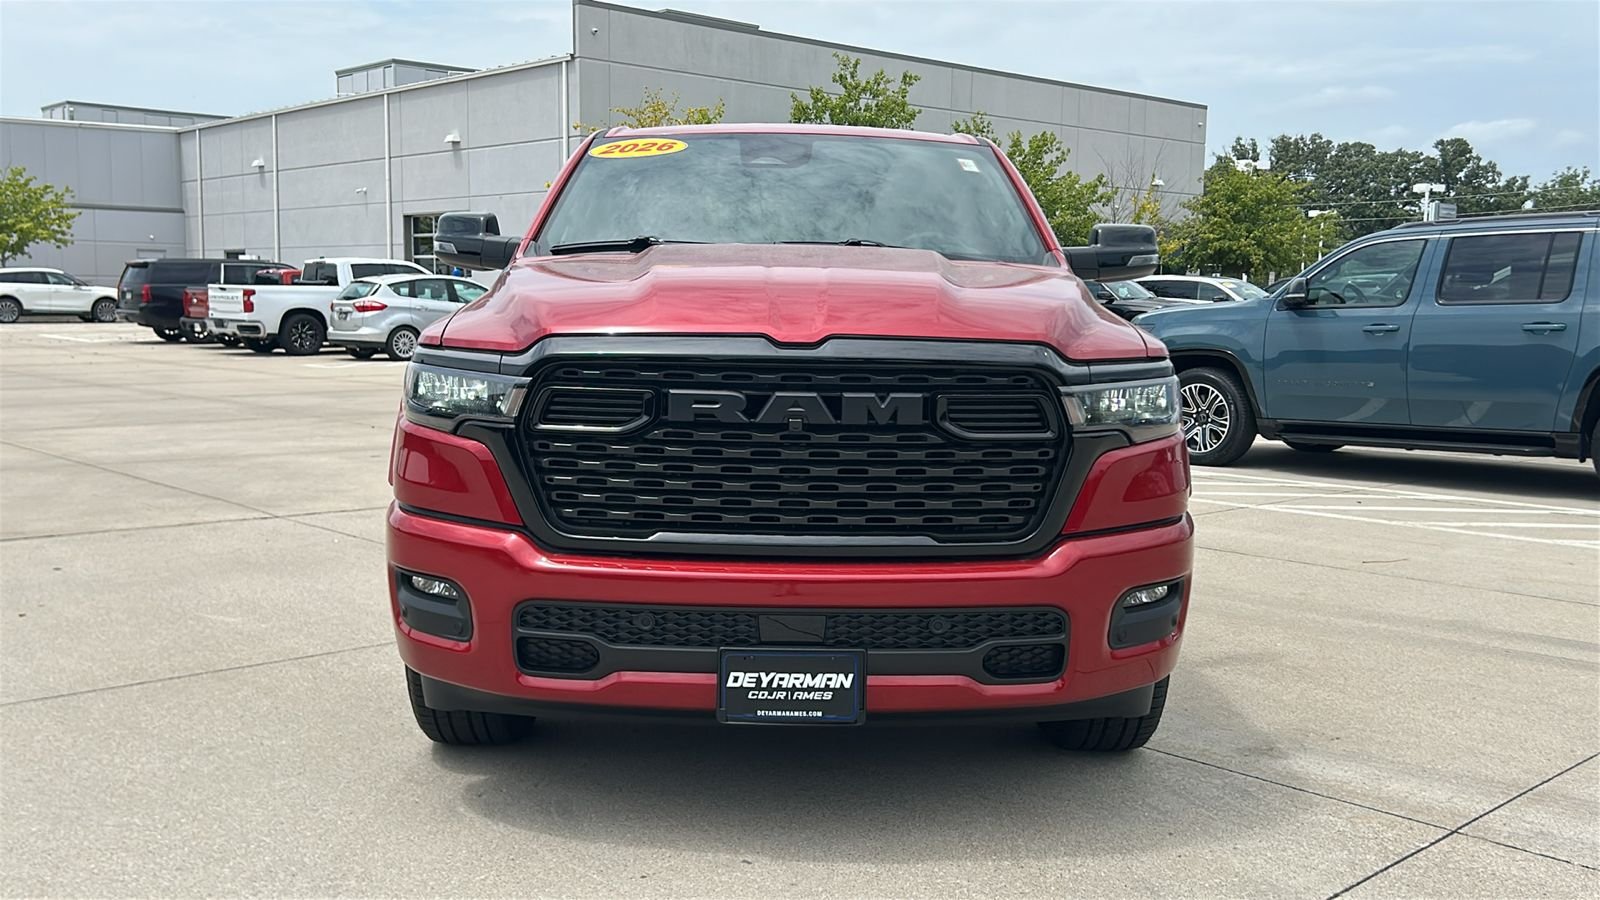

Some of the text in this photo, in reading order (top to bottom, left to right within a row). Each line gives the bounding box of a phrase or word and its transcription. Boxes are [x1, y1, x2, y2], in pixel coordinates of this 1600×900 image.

[599, 142, 677, 154] 2026
[668, 389, 923, 425] RAM
[726, 671, 854, 689] DEYARMAN
[757, 709, 823, 717] DEYARMANAMES.COM
